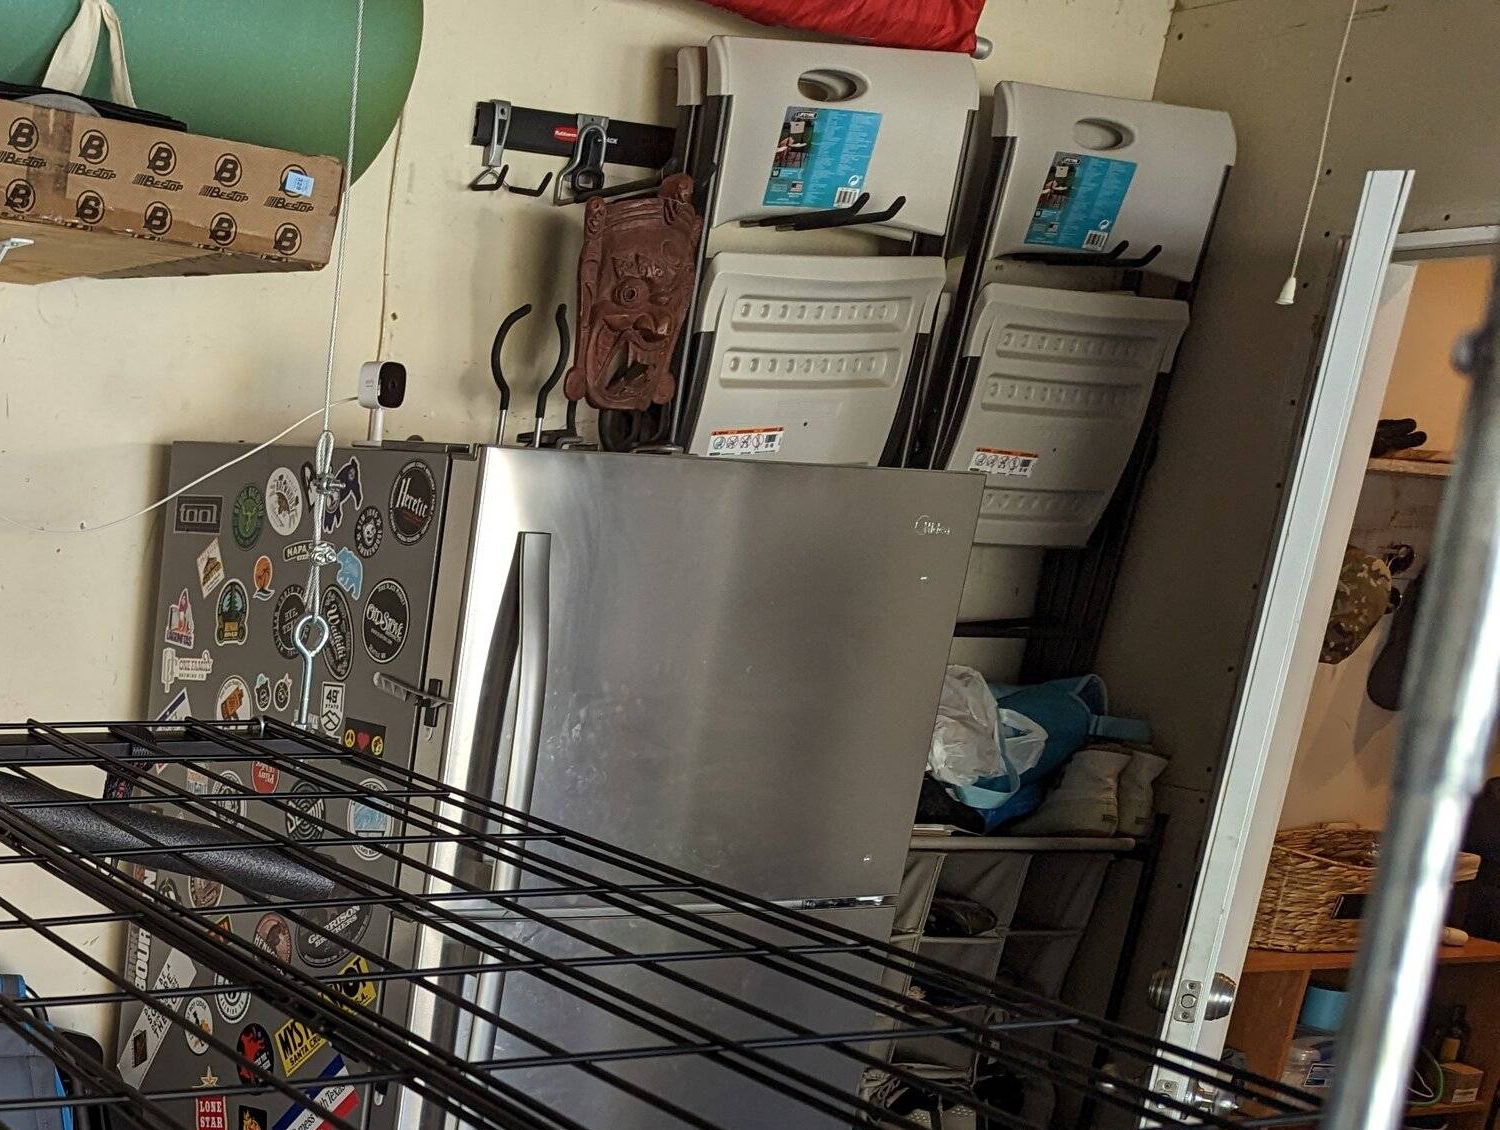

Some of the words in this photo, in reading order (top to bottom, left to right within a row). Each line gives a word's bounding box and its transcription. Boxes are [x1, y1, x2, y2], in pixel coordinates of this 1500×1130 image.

[395, 477, 429, 518] Heretic
[200, 1101, 222, 1112] LONE
[200, 1117, 223, 1128] STAR
